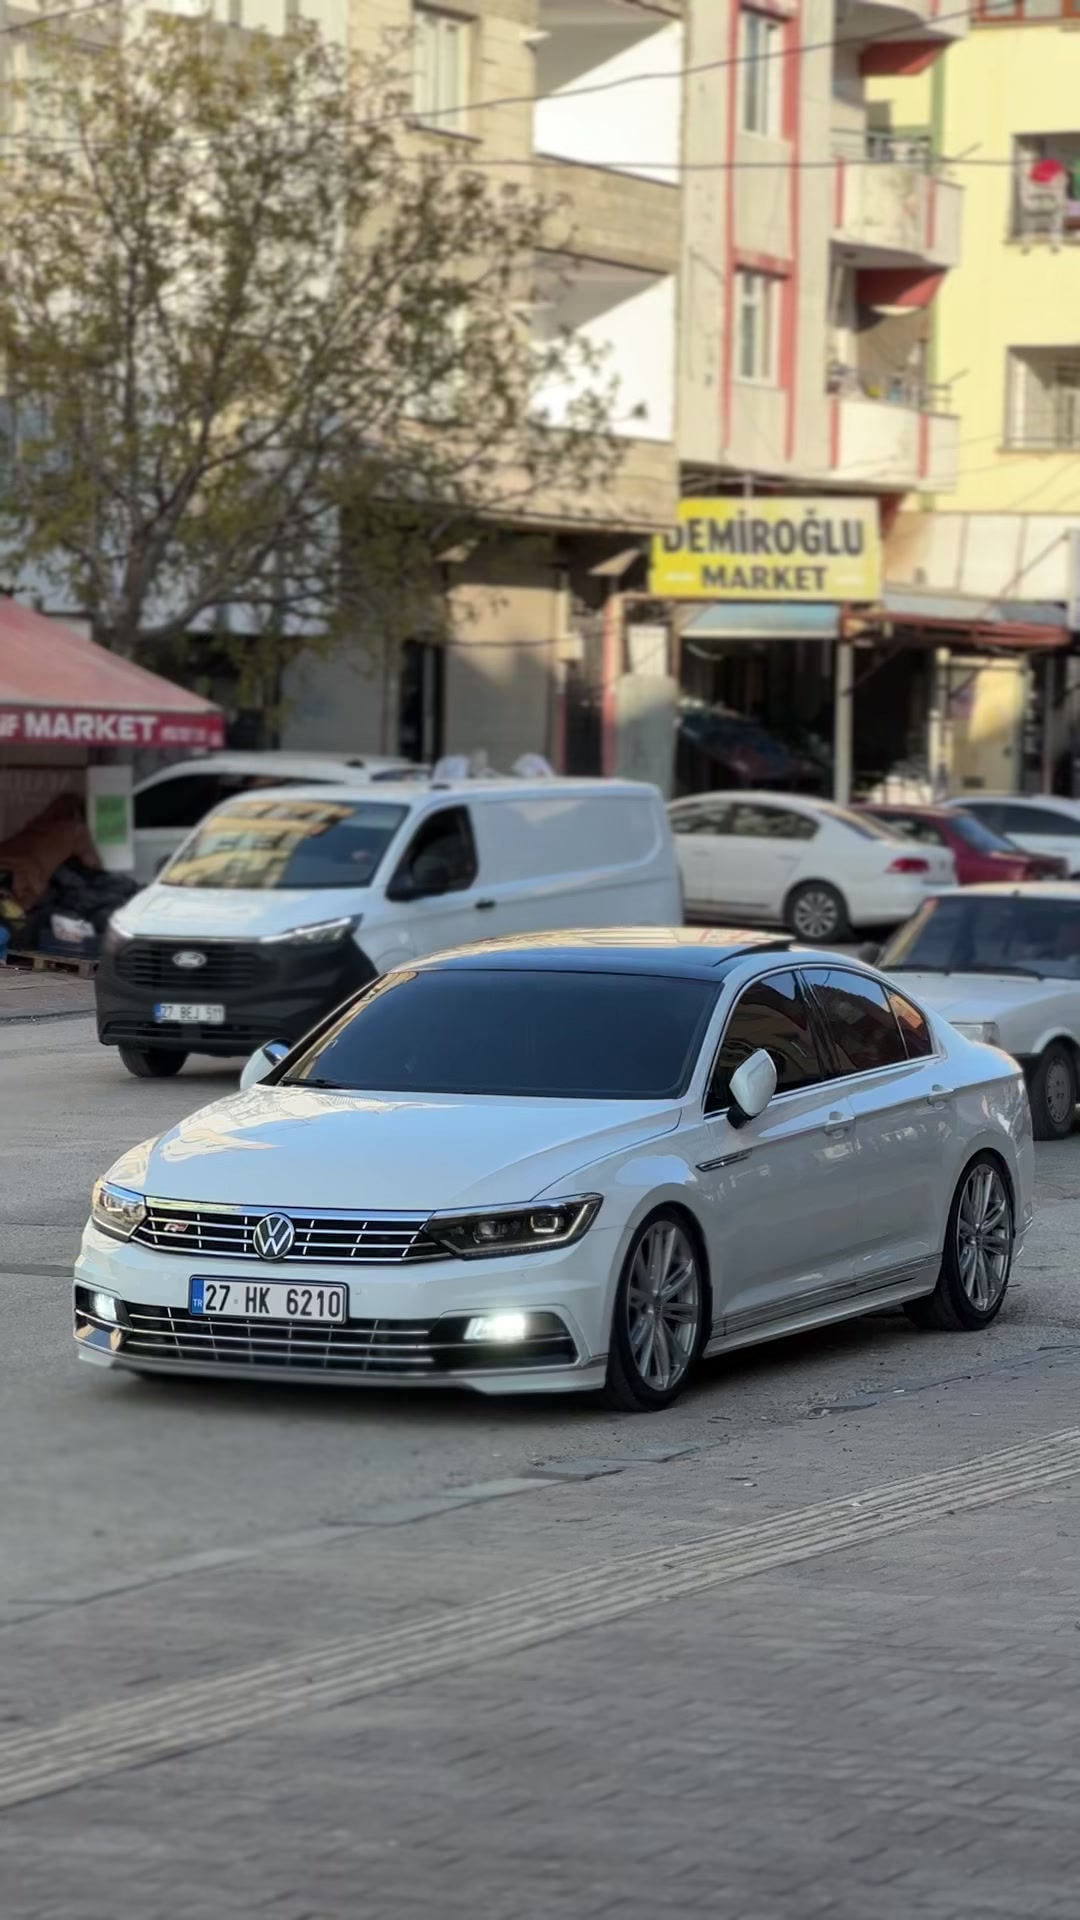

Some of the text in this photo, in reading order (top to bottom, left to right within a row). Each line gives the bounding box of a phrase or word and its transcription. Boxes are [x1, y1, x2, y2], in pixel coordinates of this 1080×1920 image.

[663, 508, 863, 556] DEMİROĞLU
[702, 565, 828, 590] MARKET
[24, 711, 158, 741] MARKET
[161, 1005, 173, 1019] 27
[181, 1005, 199, 1019] BEJ
[193, 1299, 203, 1308] TR
[205, 1284, 341, 1317] 27 HK 6210
